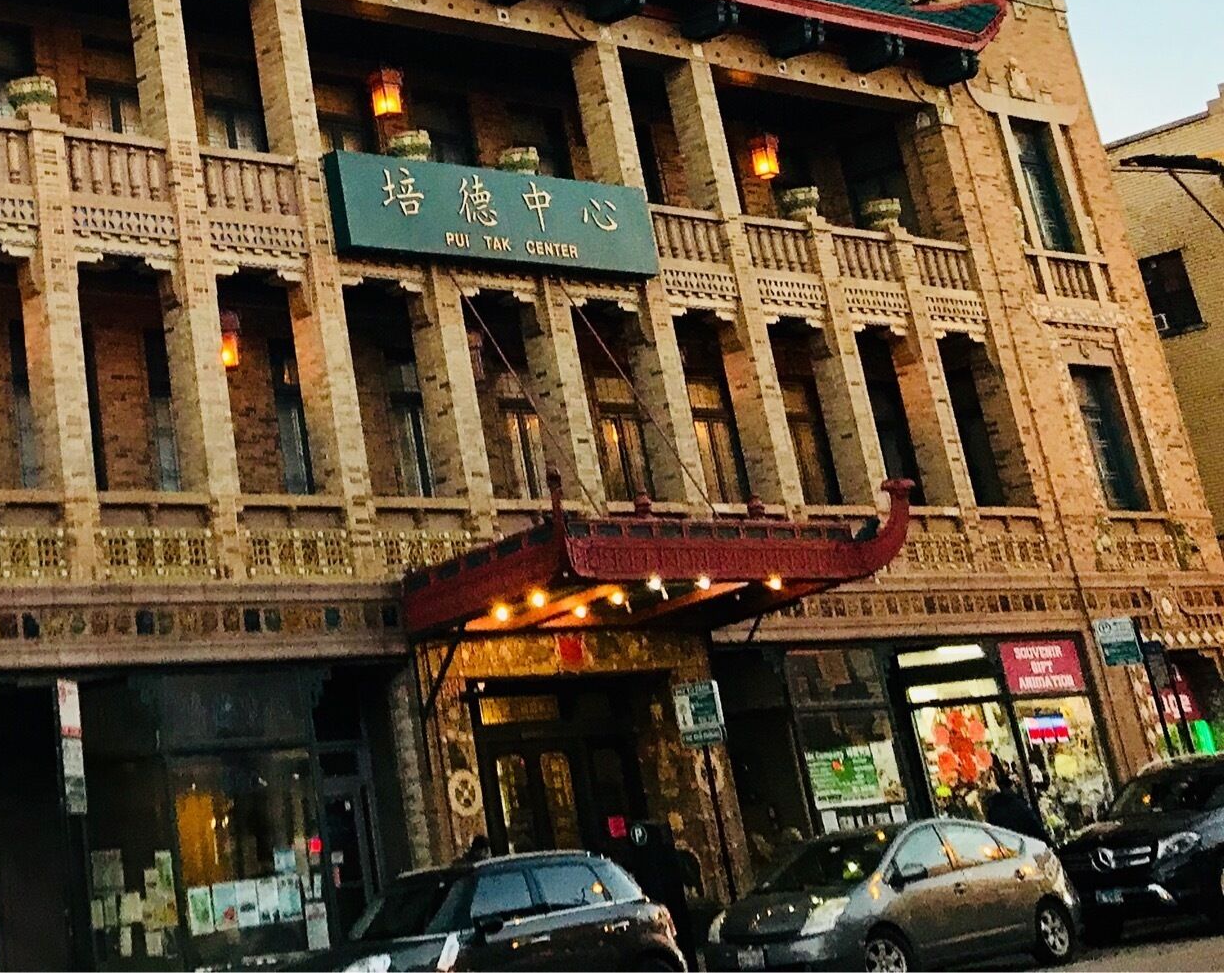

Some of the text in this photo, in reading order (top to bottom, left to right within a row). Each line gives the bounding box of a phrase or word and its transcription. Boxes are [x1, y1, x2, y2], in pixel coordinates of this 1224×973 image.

[382, 167, 618, 232] 培德中心
[445, 232, 578, 258] PUI TAK CENTER
[1013, 645, 1063, 660] SOUVENIR
[1030, 660, 1054, 674] GIFT
[1018, 674, 1075, 690] ANIMATION
